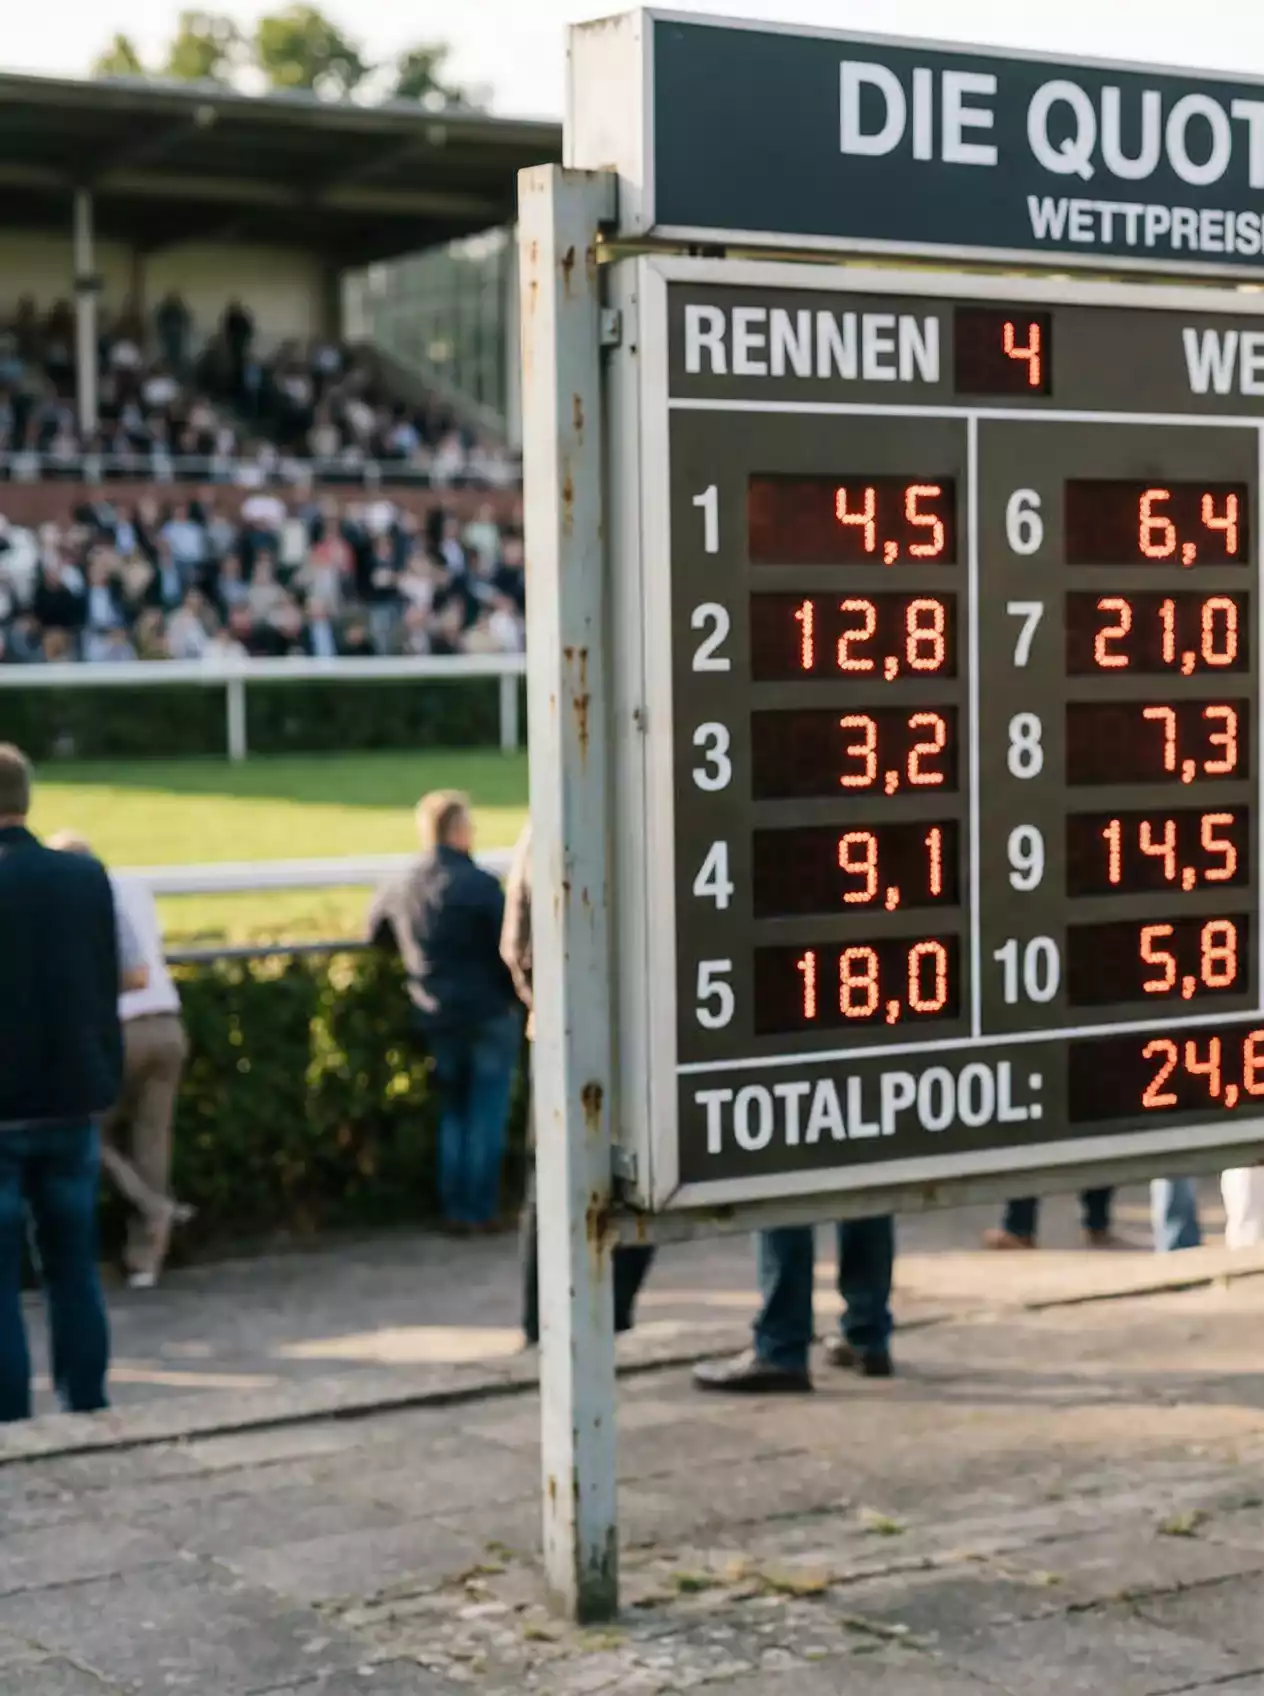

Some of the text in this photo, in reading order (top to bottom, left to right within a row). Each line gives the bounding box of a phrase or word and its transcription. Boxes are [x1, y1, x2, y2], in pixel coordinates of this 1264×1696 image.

[839, 60, 999, 166] DIE
[684, 304, 940, 382] RENNEN
[1003, 321, 1041, 386] 4
[692, 484, 719, 554] 1
[835, 484, 945, 565] 4,5
[1006, 488, 1044, 555] 6
[1138, 488, 1238, 566] 6,4
[691, 602, 732, 672] 2
[794, 598, 945, 681] 12,8
[1006, 601, 1044, 666] 7
[1094, 597, 1238, 676] 21,0
[692, 722, 733, 791] 3
[839, 714, 946, 795] 3,2
[1007, 712, 1044, 779] 8
[1142, 705, 1238, 784] 7,3
[693, 840, 735, 909] 4
[838, 827, 942, 912] 9,1
[1007, 824, 1045, 891] 9
[1102, 812, 1237, 891] 14,5
[695, 959, 736, 1029] 5
[796, 940, 947, 1025] 18,0
[993, 936, 1061, 1004] 10
[1140, 919, 1237, 1000] 5,8
[694, 1061, 1043, 1154] TOTALPOOL:
